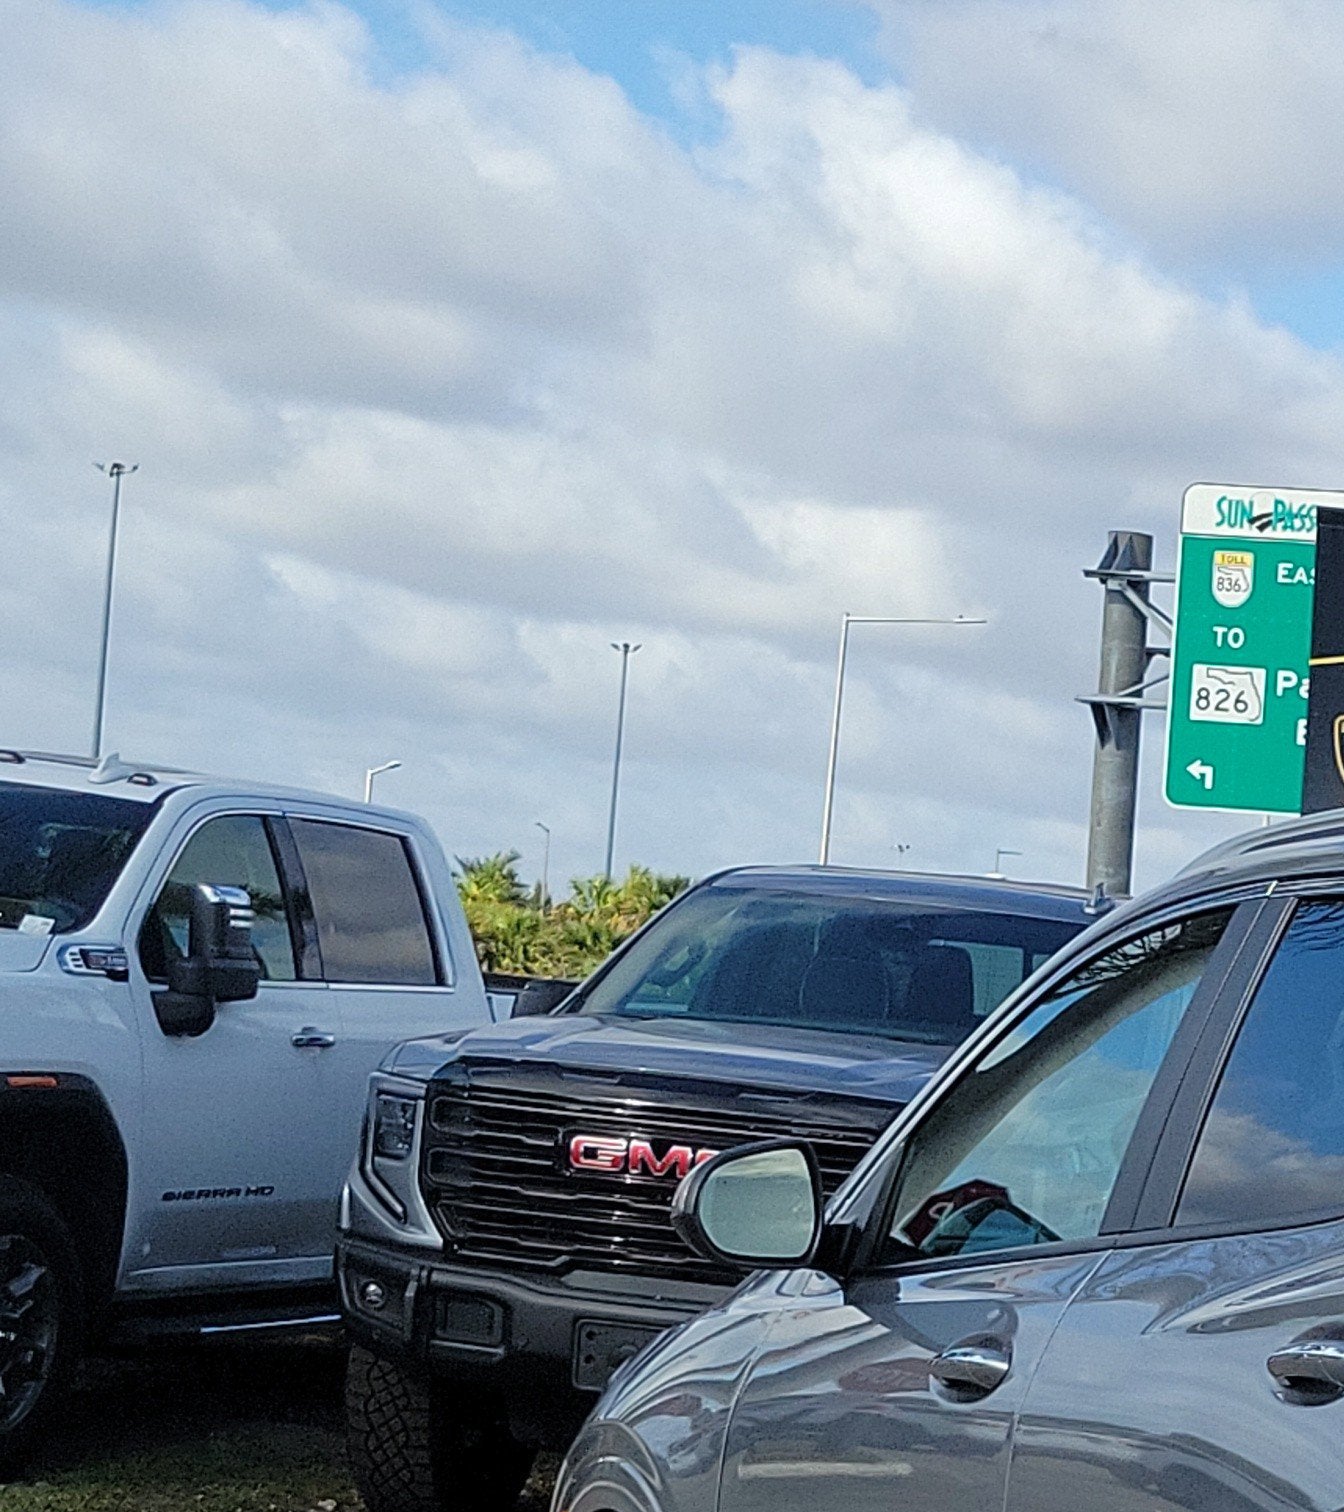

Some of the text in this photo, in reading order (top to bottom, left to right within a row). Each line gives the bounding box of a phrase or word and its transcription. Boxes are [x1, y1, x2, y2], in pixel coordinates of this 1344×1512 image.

[1221, 554, 1248, 565] TOLL
[1216, 576, 1242, 592] 836
[1212, 625, 1245, 649] TO
[1195, 687, 1249, 714] 826
